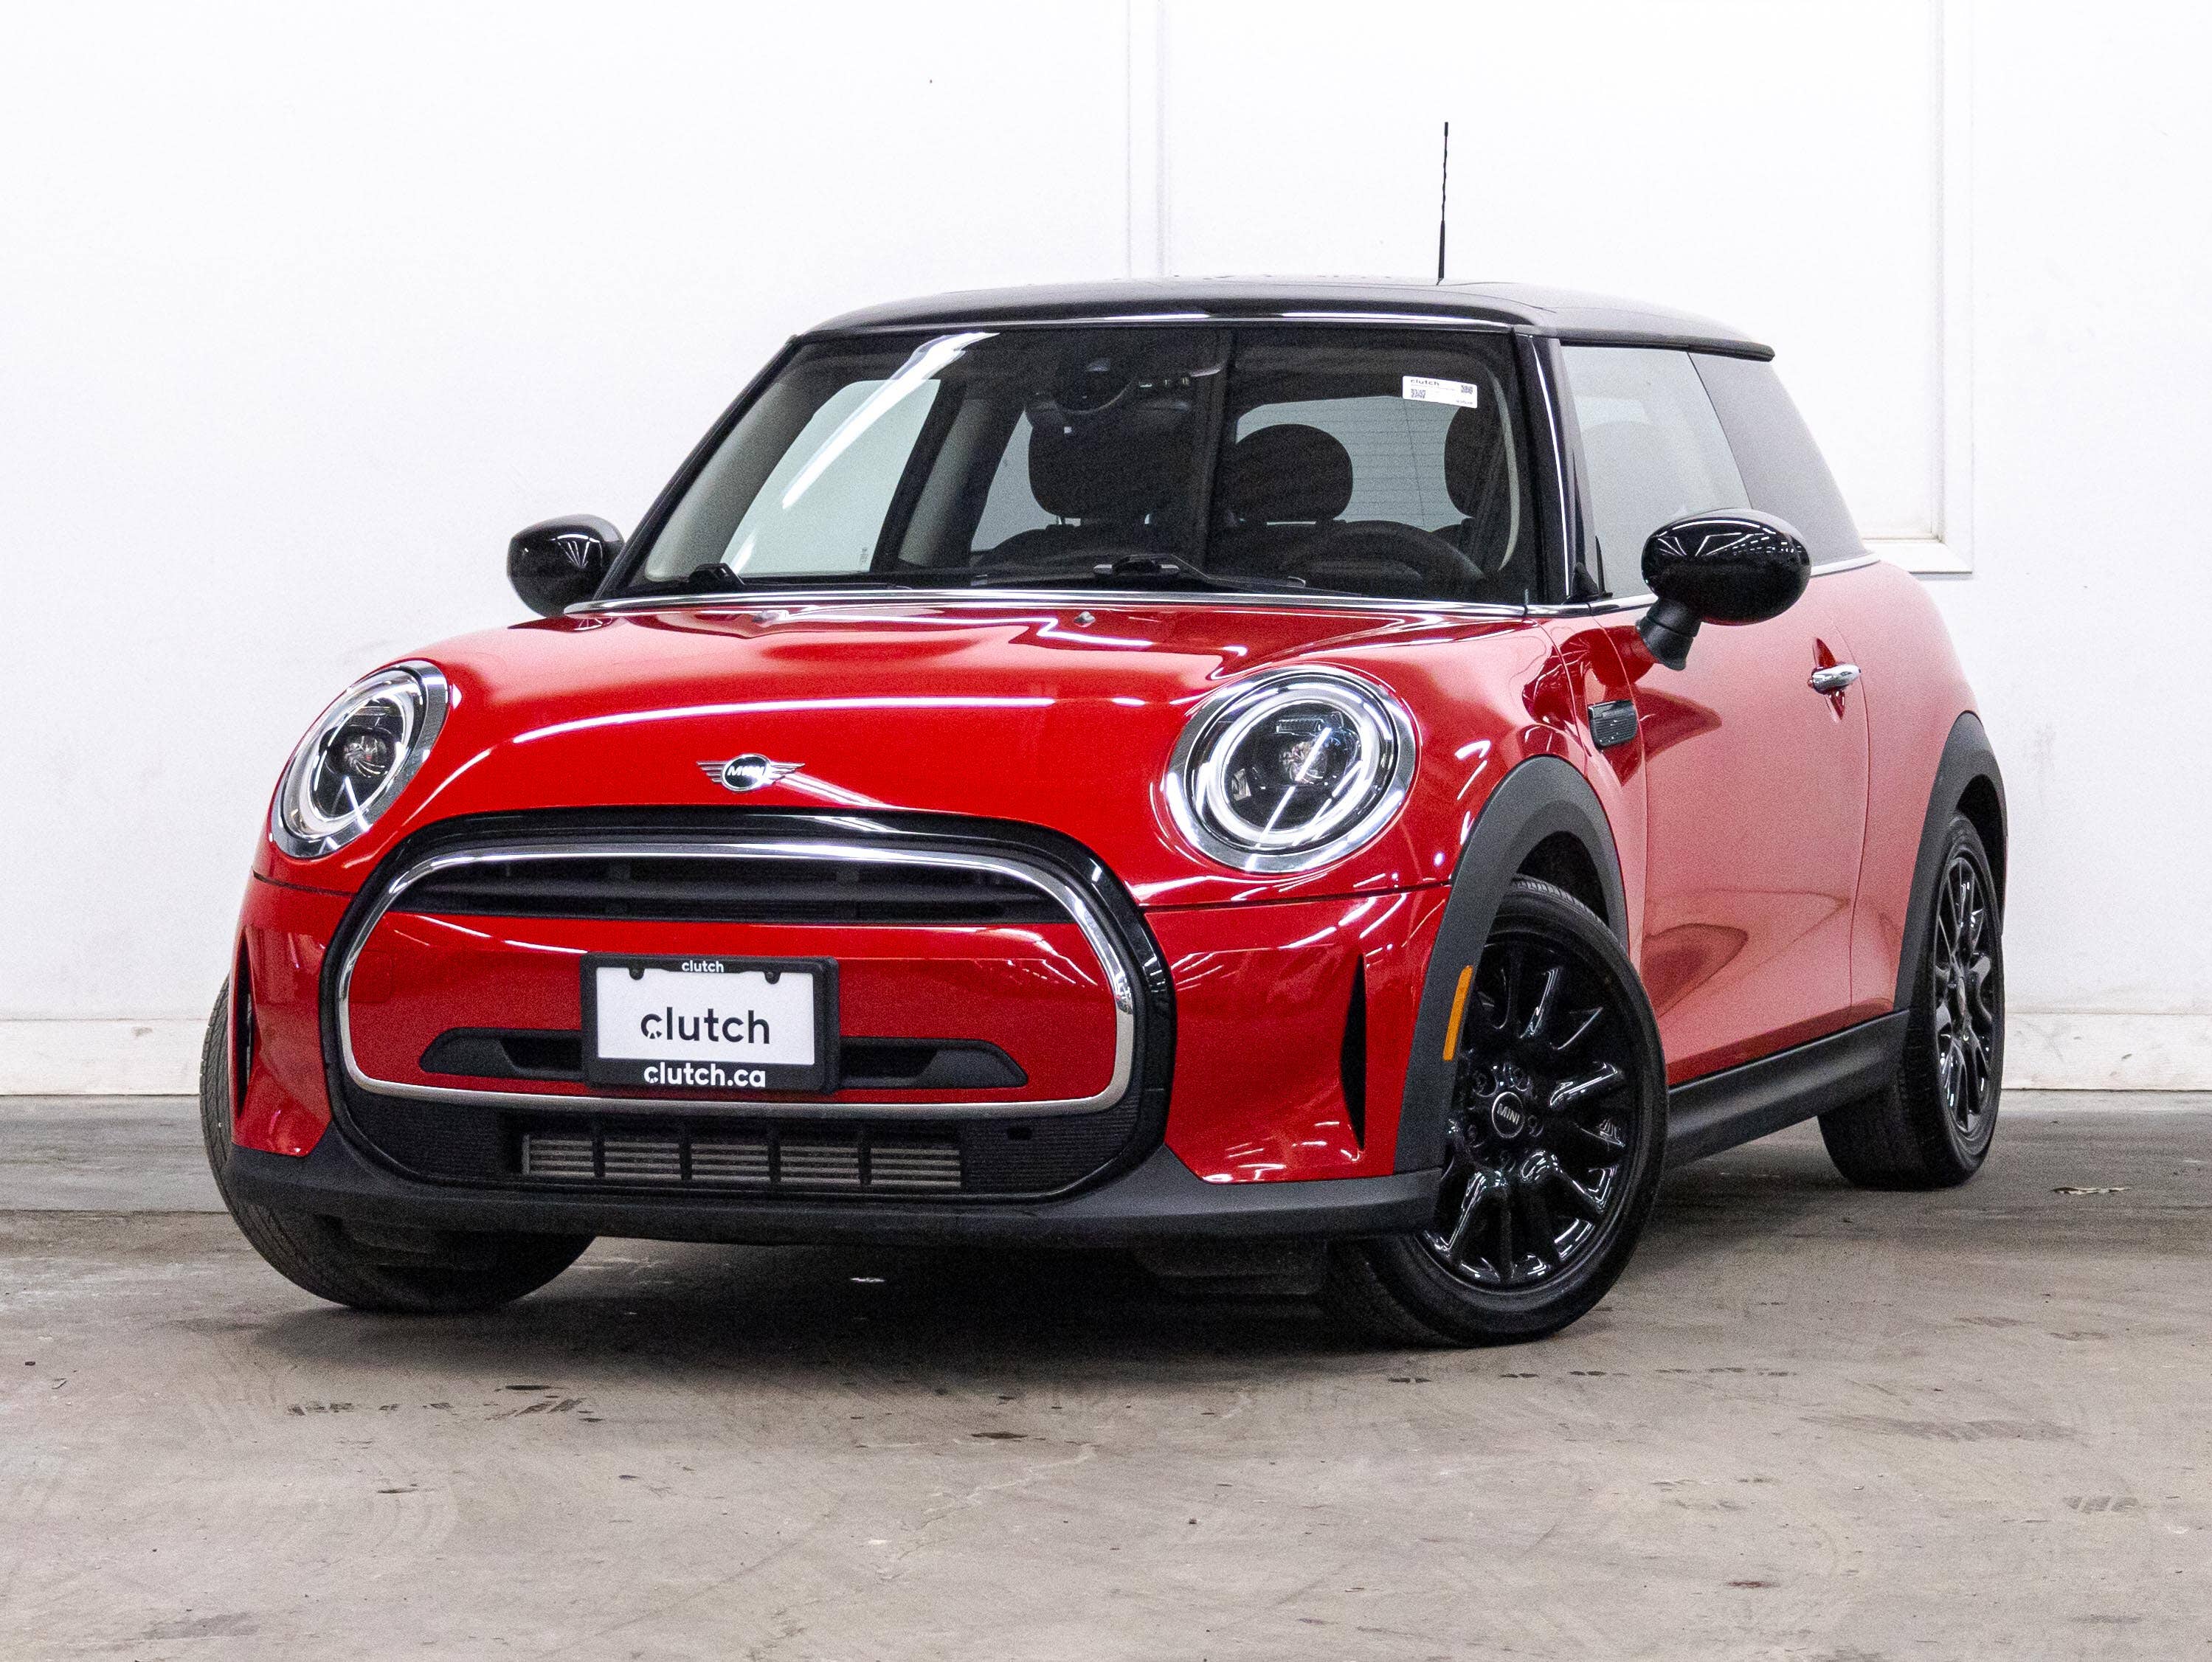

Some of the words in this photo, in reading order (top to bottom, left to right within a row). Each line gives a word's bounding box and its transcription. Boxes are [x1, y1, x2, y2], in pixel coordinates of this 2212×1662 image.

[727, 766, 764, 776] MI
[682, 960, 724, 973] clutch
[640, 1006, 770, 1044] clutch
[643, 1062, 766, 1087] clutch.ca
[1497, 1103, 1520, 1125] MINI
